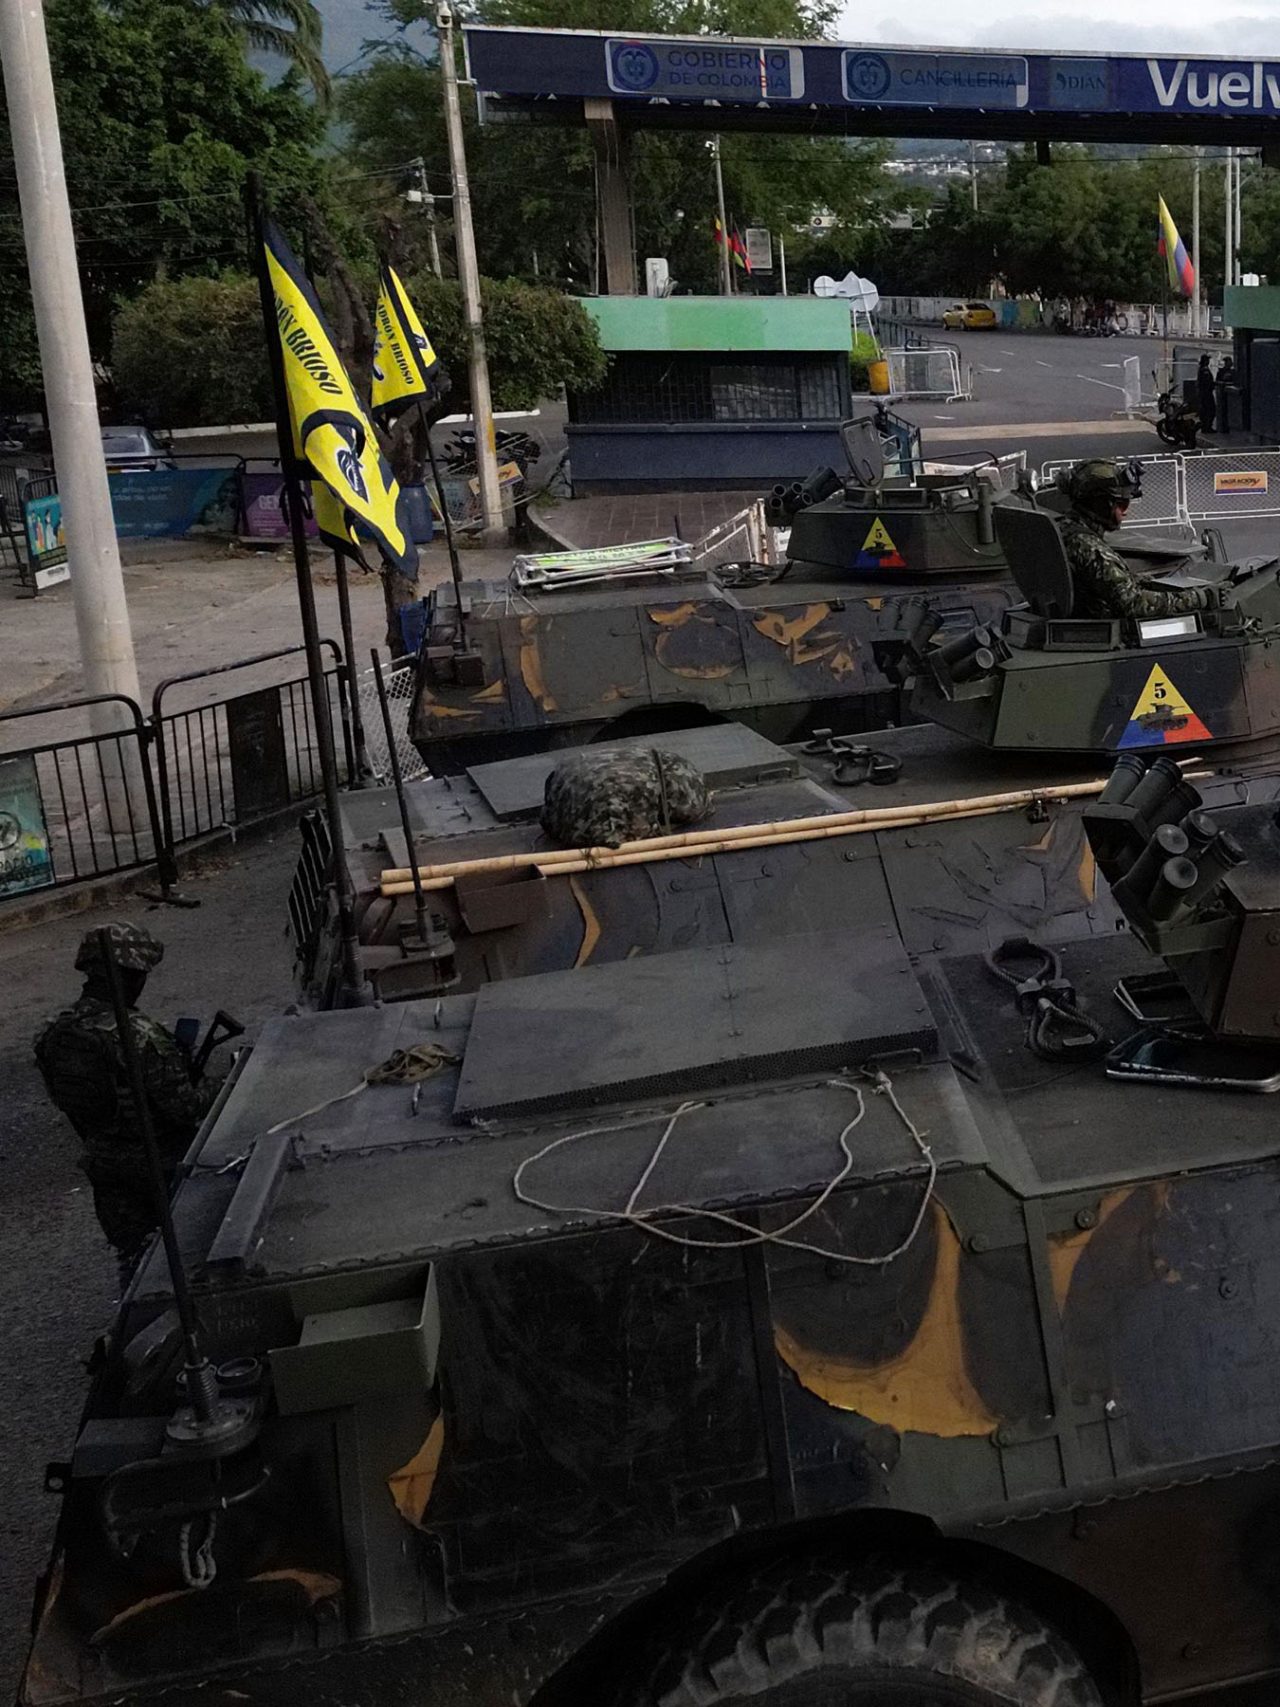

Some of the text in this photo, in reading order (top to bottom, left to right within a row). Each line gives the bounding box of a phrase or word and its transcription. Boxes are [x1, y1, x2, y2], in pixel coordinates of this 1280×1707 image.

[668, 51, 787, 71] GOBIERNO
[670, 72, 787, 89] DE COLOMBIA
[899, 68, 1017, 89] CANCILLERÍA
[285, 327, 343, 395] BRIOSO
[391, 342, 414, 385] BRIOSO
[876, 528, 882, 539] 5
[1154, 682, 1167, 699] 5
